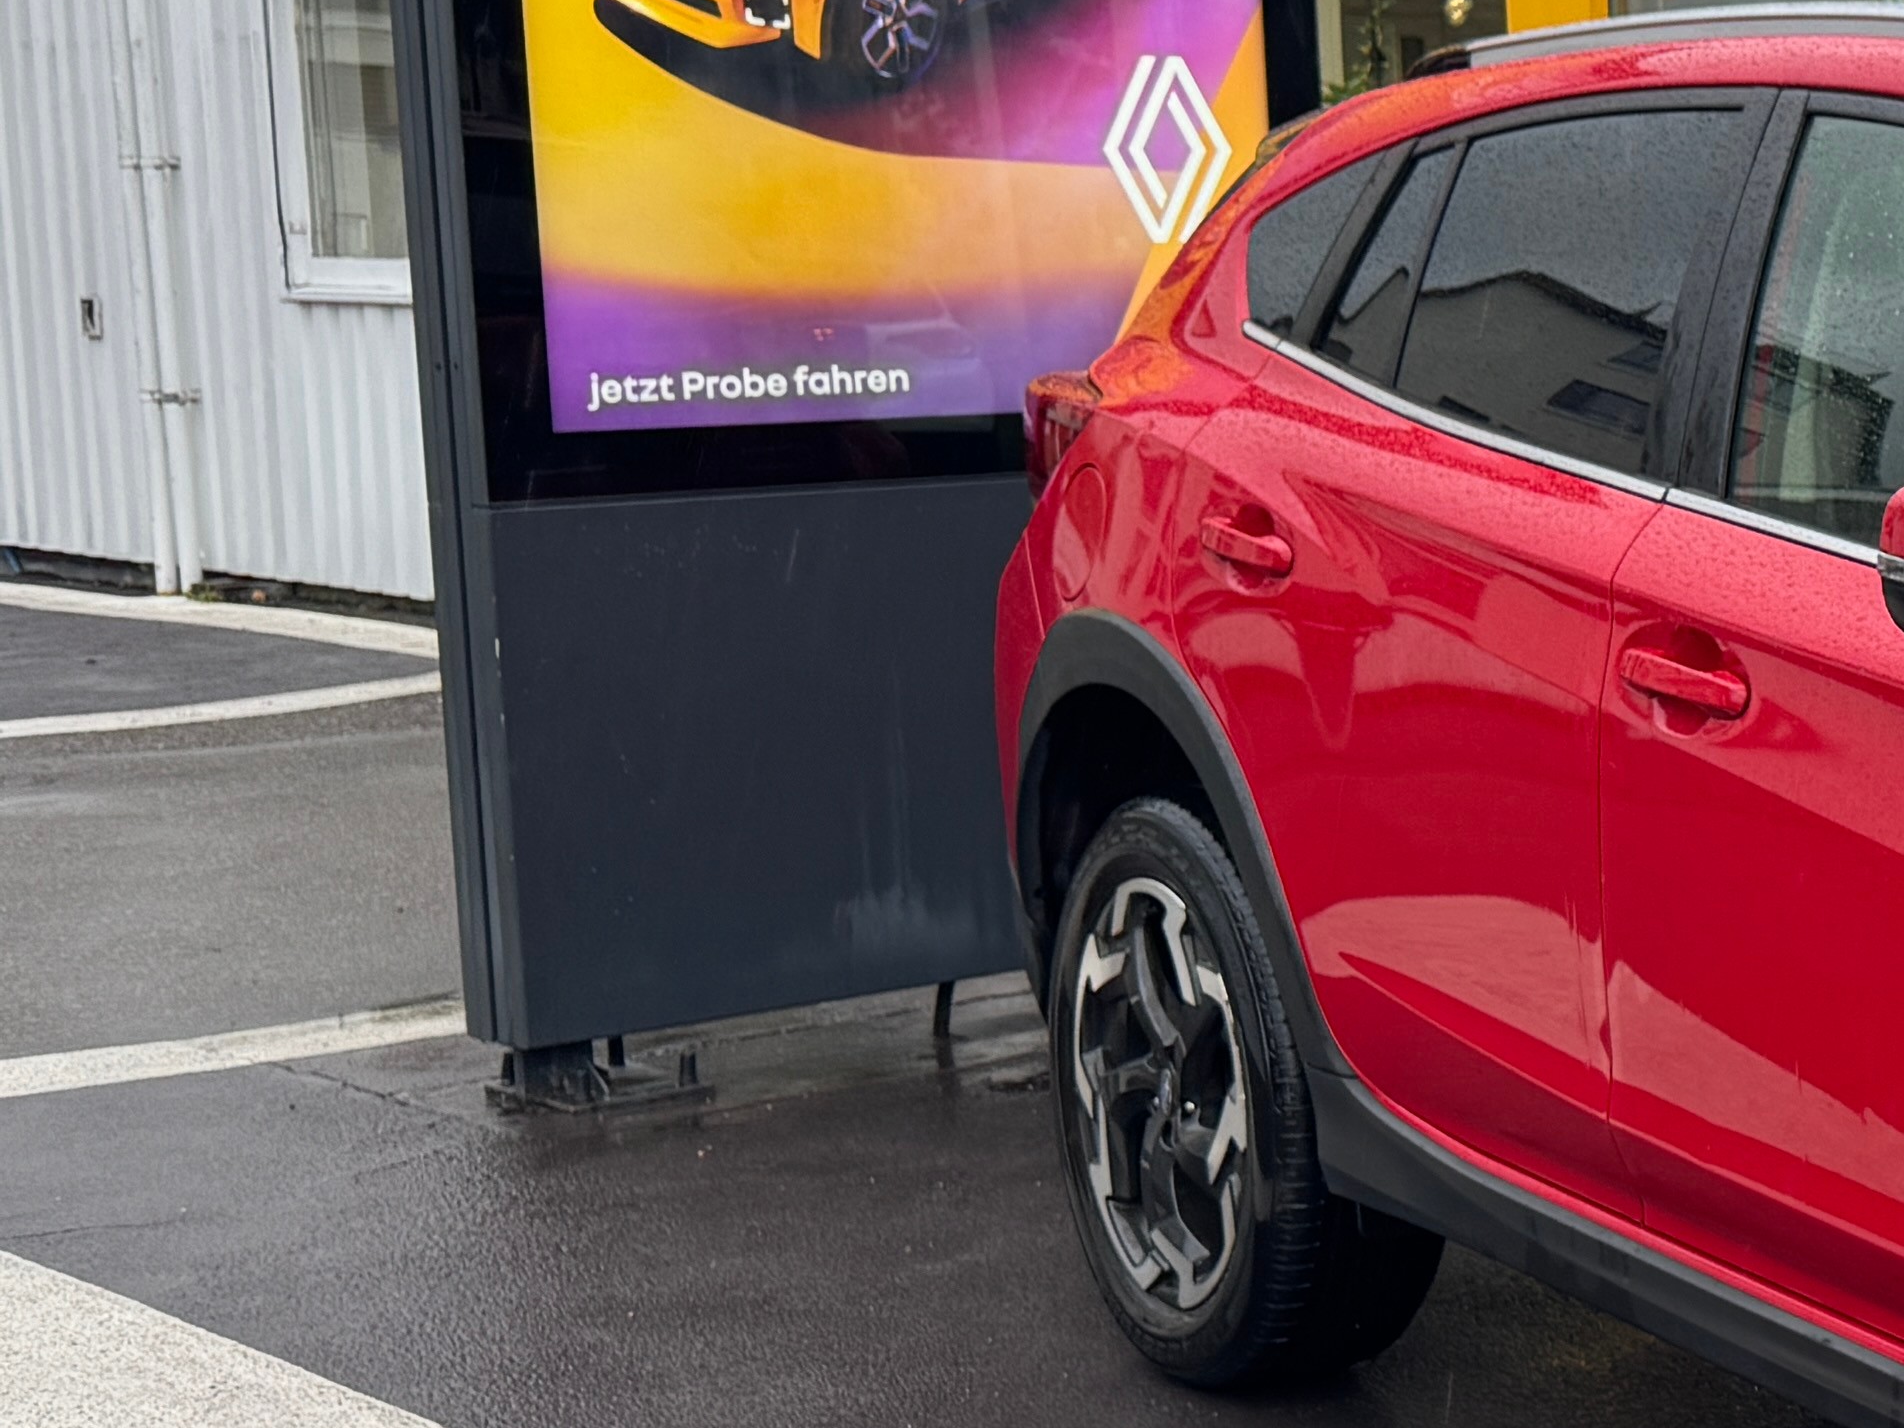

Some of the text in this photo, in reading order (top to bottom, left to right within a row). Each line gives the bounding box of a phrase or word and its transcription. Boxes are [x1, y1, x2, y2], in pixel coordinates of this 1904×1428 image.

[587, 363, 910, 412] jetzt Probe fahren
